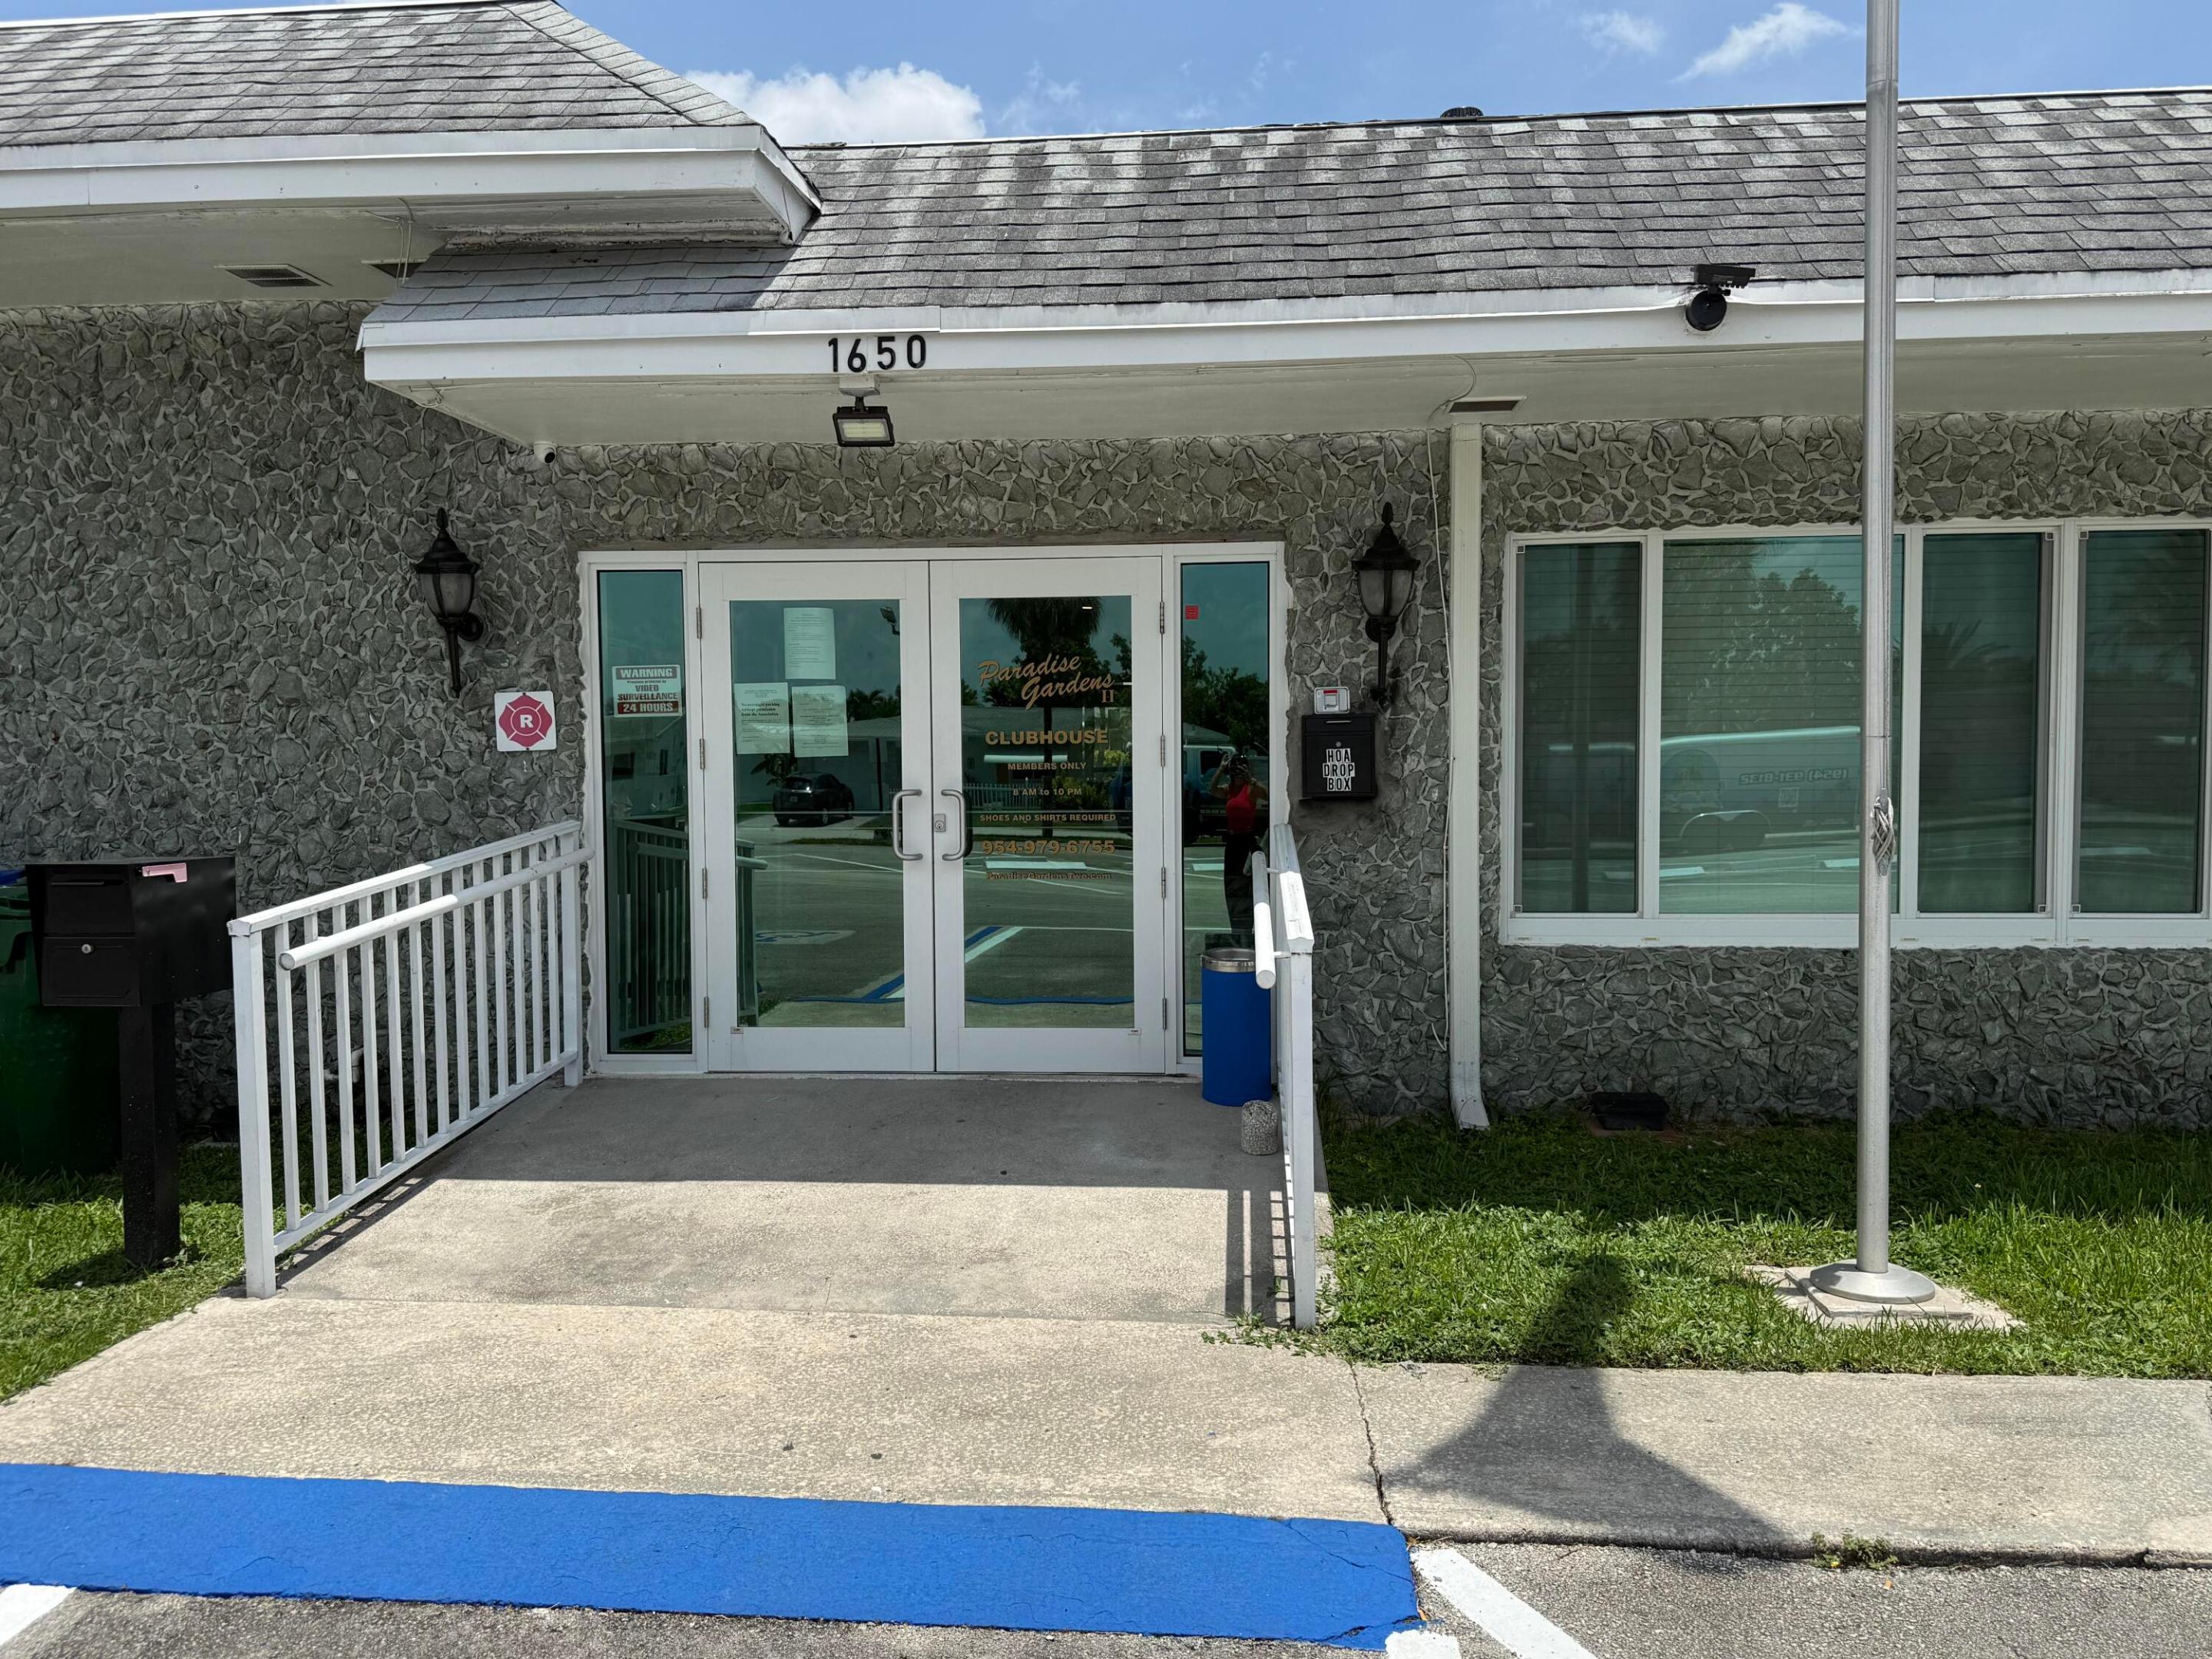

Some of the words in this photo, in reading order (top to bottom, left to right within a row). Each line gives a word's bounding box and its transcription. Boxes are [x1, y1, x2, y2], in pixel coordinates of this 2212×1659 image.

[828, 335, 926, 373] 1650
[621, 668, 673, 678] WARNING
[978, 651, 1081, 687] Paradise
[618, 693, 678, 701] SURVEILLANCE
[1021, 671, 1115, 710] Gardens
[1101, 689, 1115, 703] II
[623, 703, 637, 713] 24
[640, 702, 674, 712] HOURS
[520, 714, 534, 728] R
[985, 730, 1108, 745] CLUBHOUSE
[1327, 750, 1349, 763] HOA
[1323, 764, 1353, 777] DROP
[1328, 777, 1350, 790] BOX
[982, 839, 1116, 855] 954-979-6755
